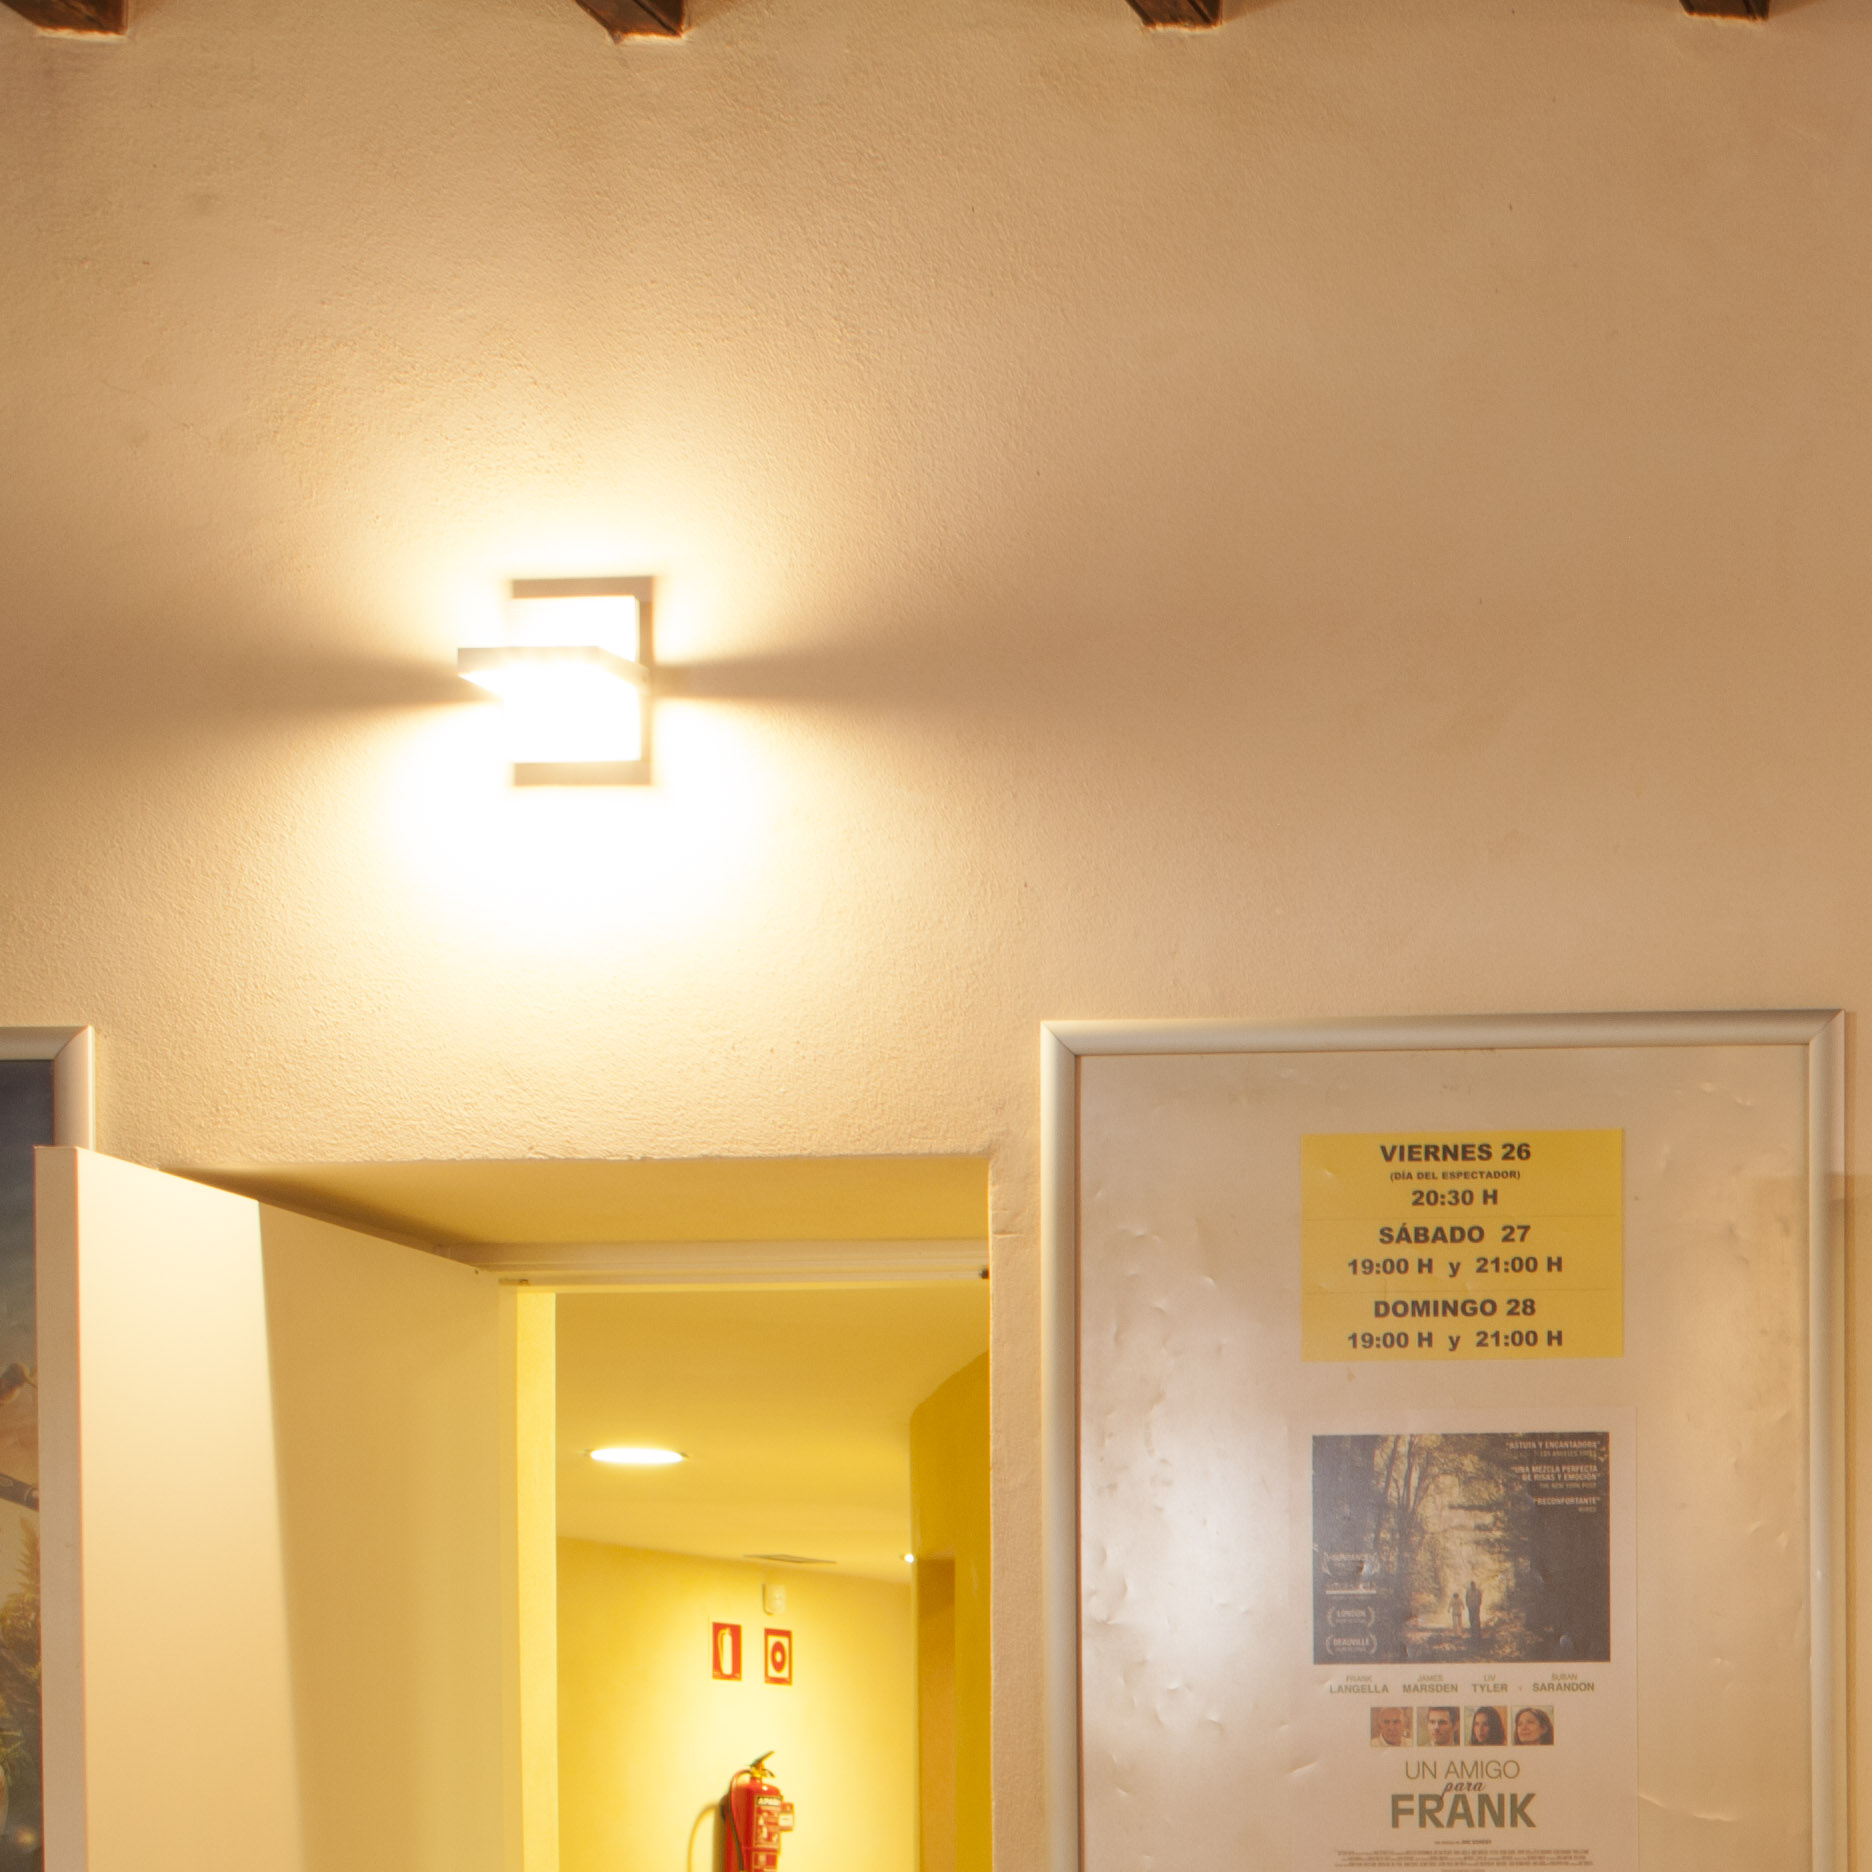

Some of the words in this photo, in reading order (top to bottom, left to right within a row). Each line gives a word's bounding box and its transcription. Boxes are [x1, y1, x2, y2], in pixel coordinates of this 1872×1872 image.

[1380, 1144, 1492, 1162] VIERNES
[1501, 1143, 1531, 1161] 26
[1390, 1170, 1413, 1182] (DÍA
[1417, 1171, 1438, 1181] DEL
[1442, 1170, 1520, 1181] ESPECTADOR)
[1411, 1189, 1474, 1206] 20:30
[1482, 1188, 1498, 1205] H
[1379, 1222, 1485, 1245] SÁBADO
[1501, 1225, 1531, 1242] 27
[1347, 1258, 1409, 1275] 19:00
[1417, 1258, 1433, 1274] H
[1448, 1261, 1461, 1278] y
[1475, 1256, 1538, 1274] 21:00
[1546, 1256, 1563, 1273] H
[1373, 1299, 1498, 1319] DOMINGO
[1506, 1298, 1536, 1316] 28
[1347, 1332, 1409, 1349] 19:00
[1417, 1331, 1433, 1348] H
[1448, 1334, 1461, 1352] y
[1475, 1330, 1538, 1348] 21:00
[1546, 1330, 1563, 1346] H
[1417, 1674, 1443, 1682] JAMES
[1471, 1682, 1508, 1693] TYLER
[1532, 1682, 1595, 1692] SARANDON
[1329, 1683, 1389, 1694] LANGELLA
[1402, 1683, 1458, 1693] MARSDEN
[1405, 1760, 1437, 1780] UN
[1444, 1759, 1520, 1779] AMIGO
[1441, 1780, 1486, 1800] para
[1391, 1793, 1537, 1829] FRANK
